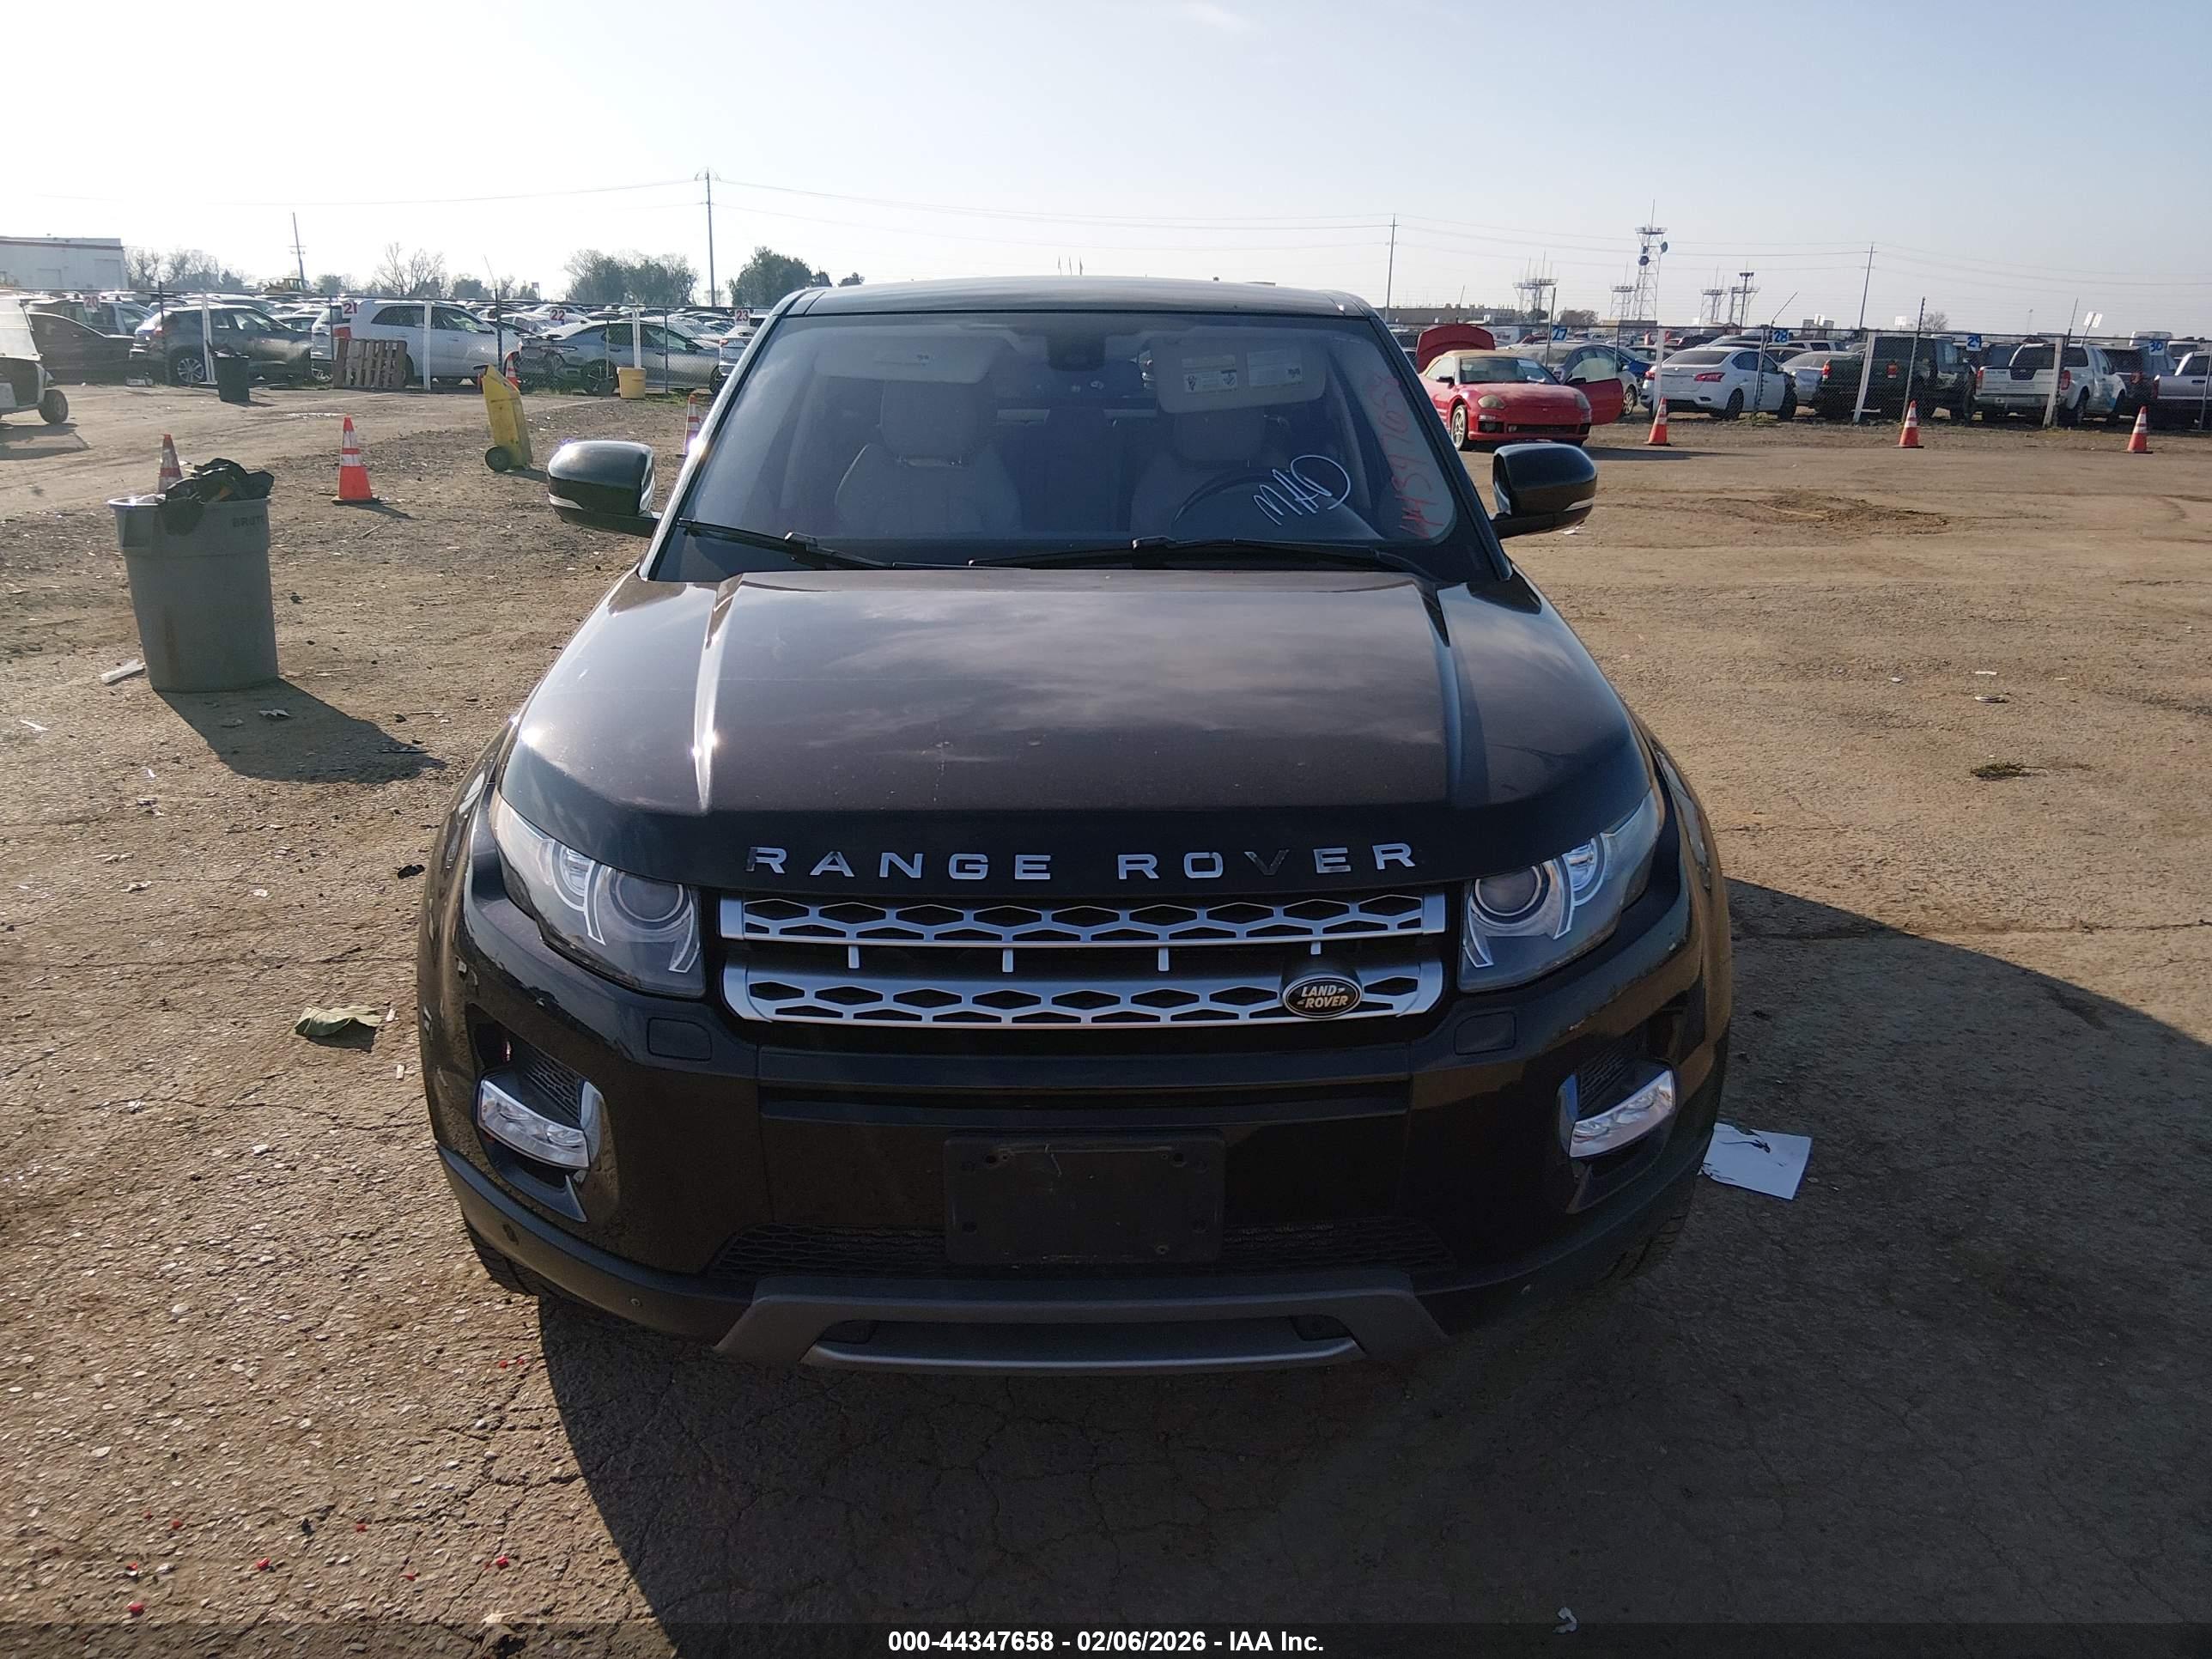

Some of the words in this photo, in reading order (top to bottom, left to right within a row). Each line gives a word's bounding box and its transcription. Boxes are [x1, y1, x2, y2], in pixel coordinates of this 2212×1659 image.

[83, 296, 99, 308] 20
[343, 302, 358, 314] 21
[550, 309, 565, 321] 22
[736, 309, 749, 321] 23
[1552, 325, 1567, 341] 27
[1773, 330, 1788, 343] 28
[1966, 335, 1982, 348] 29
[2149, 340, 2164, 352] 30
[745, 846, 1052, 881] RANGE
[1118, 842, 1415, 880] ROVER
[1301, 984, 1337, 998] LAND
[1304, 994, 1349, 1009] ROVER
